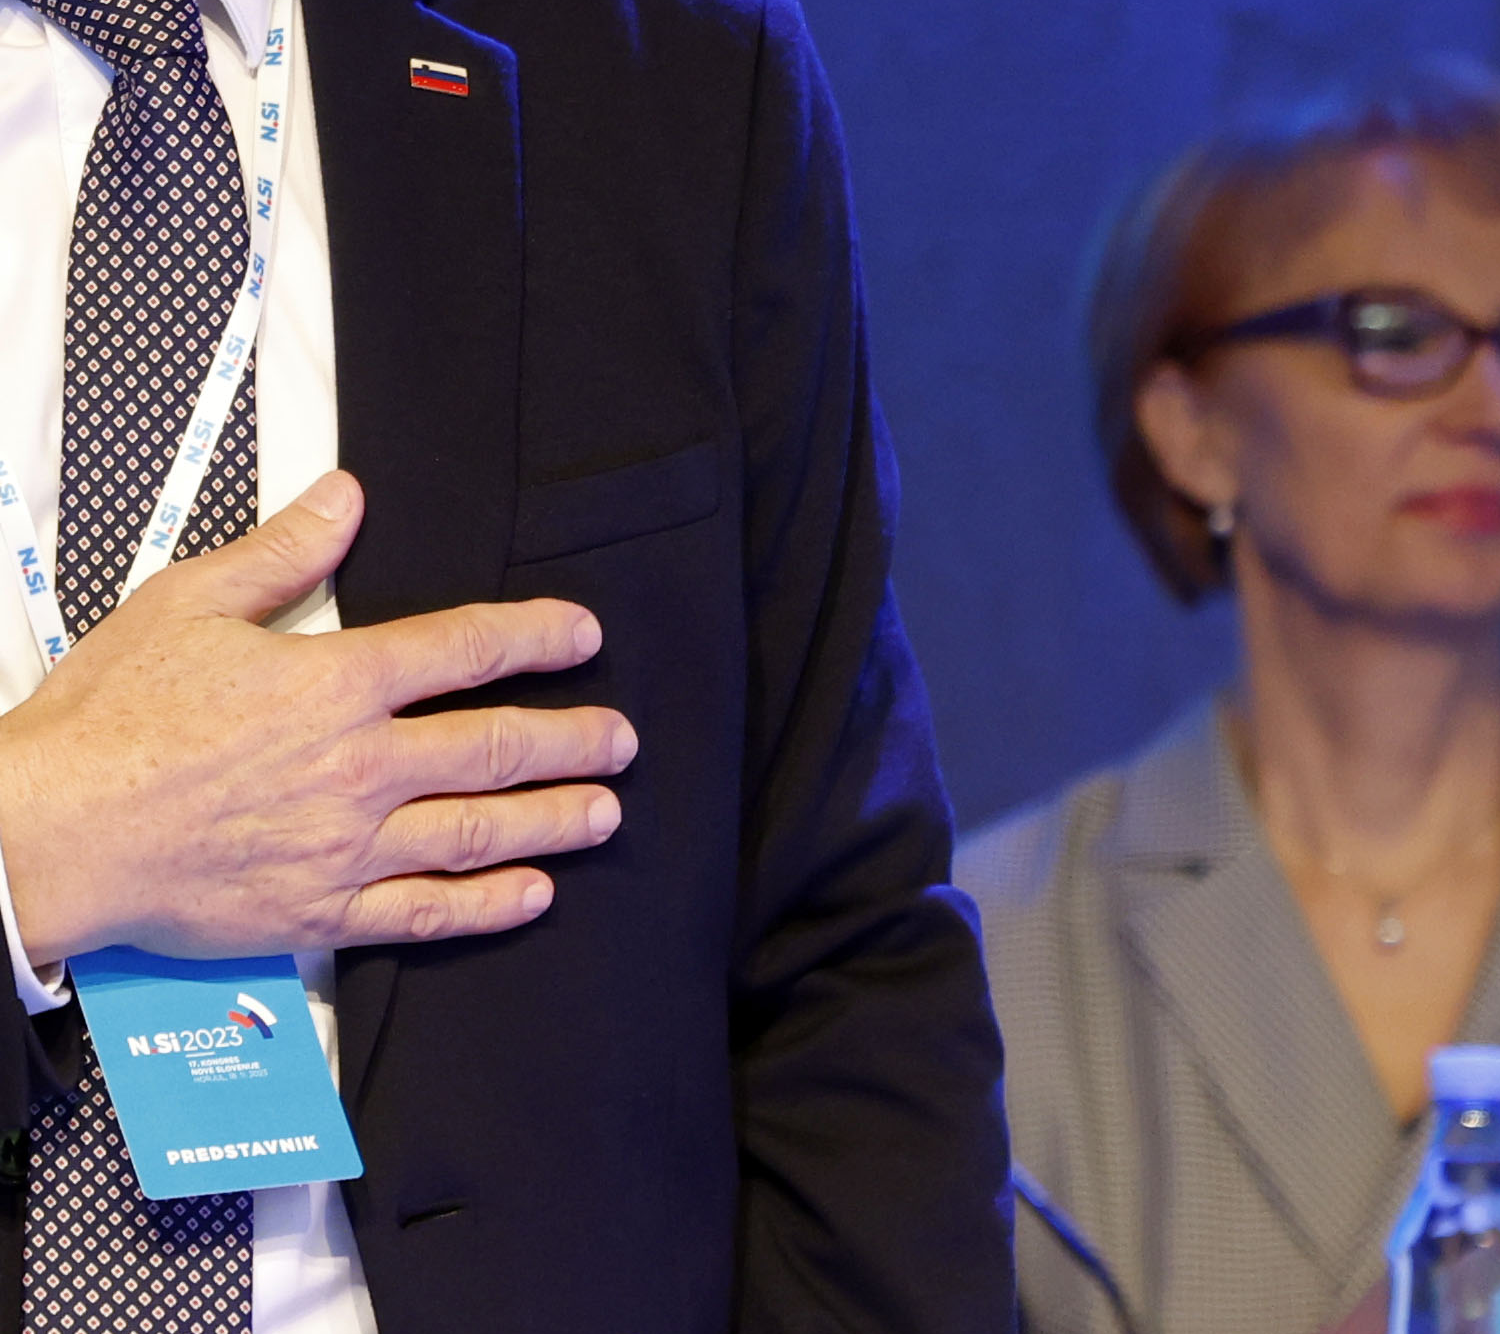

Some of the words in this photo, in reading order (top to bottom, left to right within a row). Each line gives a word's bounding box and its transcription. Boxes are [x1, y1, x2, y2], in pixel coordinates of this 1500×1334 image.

[265, 27, 284, 66] N.Si
[261, 102, 280, 143] N.Si
[256, 177, 274, 220] N.Si
[247, 253, 266, 300] N.Si
[216, 335, 246, 381] N.Si
[183, 418, 215, 465] N.Si
[149, 502, 182, 550] N.Si
[17, 546, 48, 596] N.Si
[166, 1134, 319, 1166] PREDSTAVNIK
